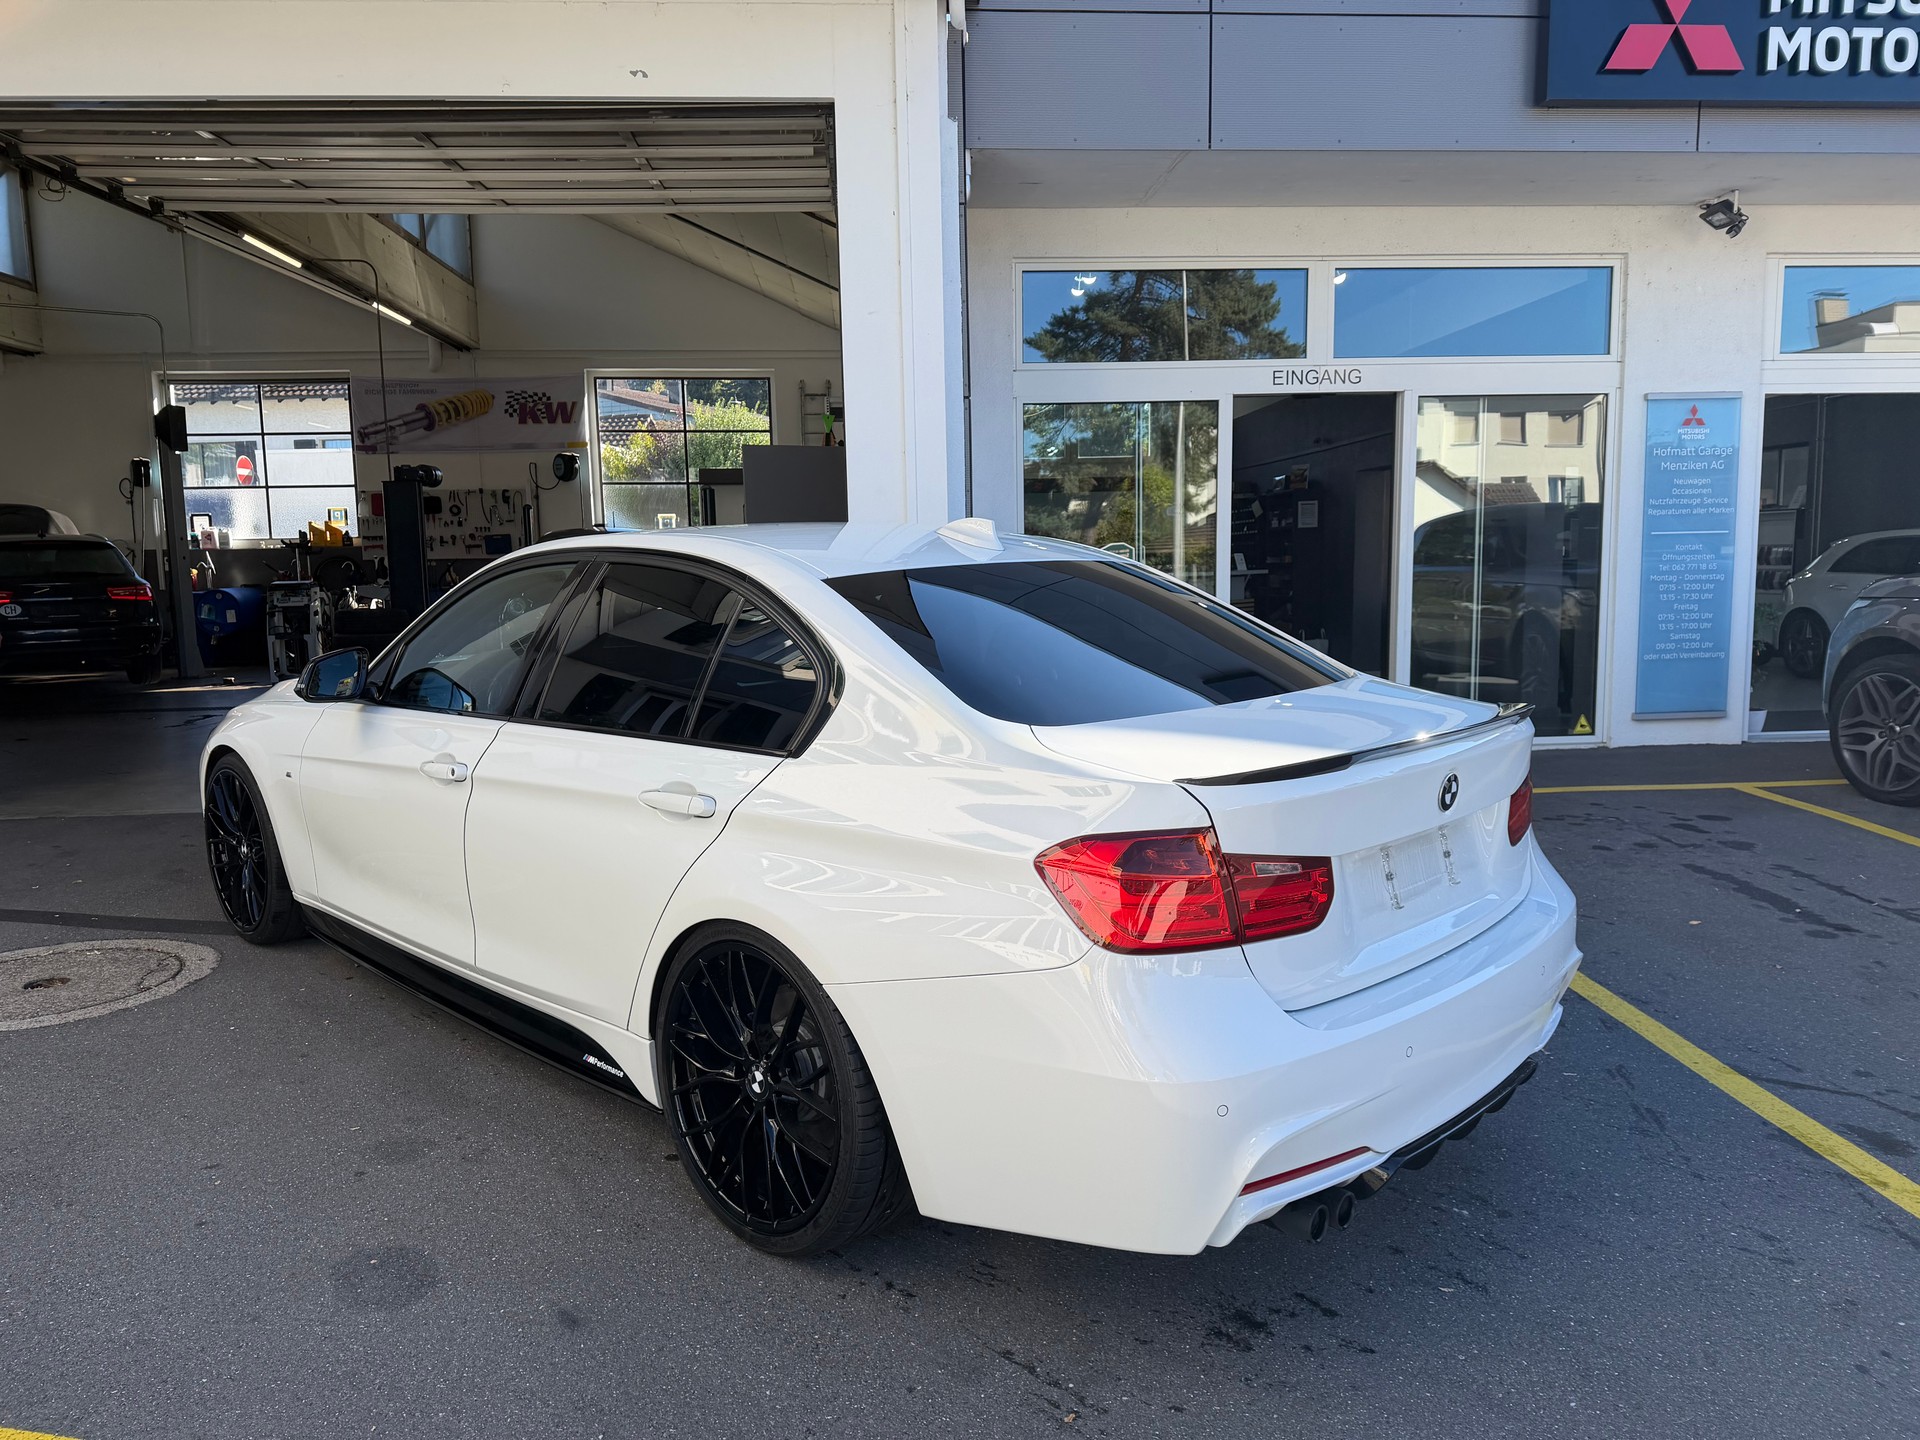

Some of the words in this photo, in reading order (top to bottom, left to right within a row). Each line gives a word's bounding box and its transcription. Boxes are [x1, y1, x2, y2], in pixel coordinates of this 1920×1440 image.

[1273, 369, 1362, 386] EINGANG
[517, 401, 577, 425] KW
[1653, 447, 1696, 457] Hofmatt
[1698, 446, 1733, 457] Garage
[1661, 461, 1708, 471] Menziken
[1710, 460, 1725, 470] AG
[1673, 478, 1711, 486] Neuwagen
[1649, 497, 1701, 506] Nutzfahrzeuge
[1703, 496, 1729, 504] Service
[1648, 508, 1691, 516] Reparaturen
[1708, 562, 1718, 570] 65
[1650, 575, 1677, 583] Montag
[1684, 573, 1725, 582] Donnerstag
[4, 605, 17, 615] CH
[1673, 603, 1699, 612] Freitag
[1670, 633, 1701, 641] Samstag
[1661, 652, 1678, 660] nach
[1680, 651, 1725, 660] Vereinbarung
